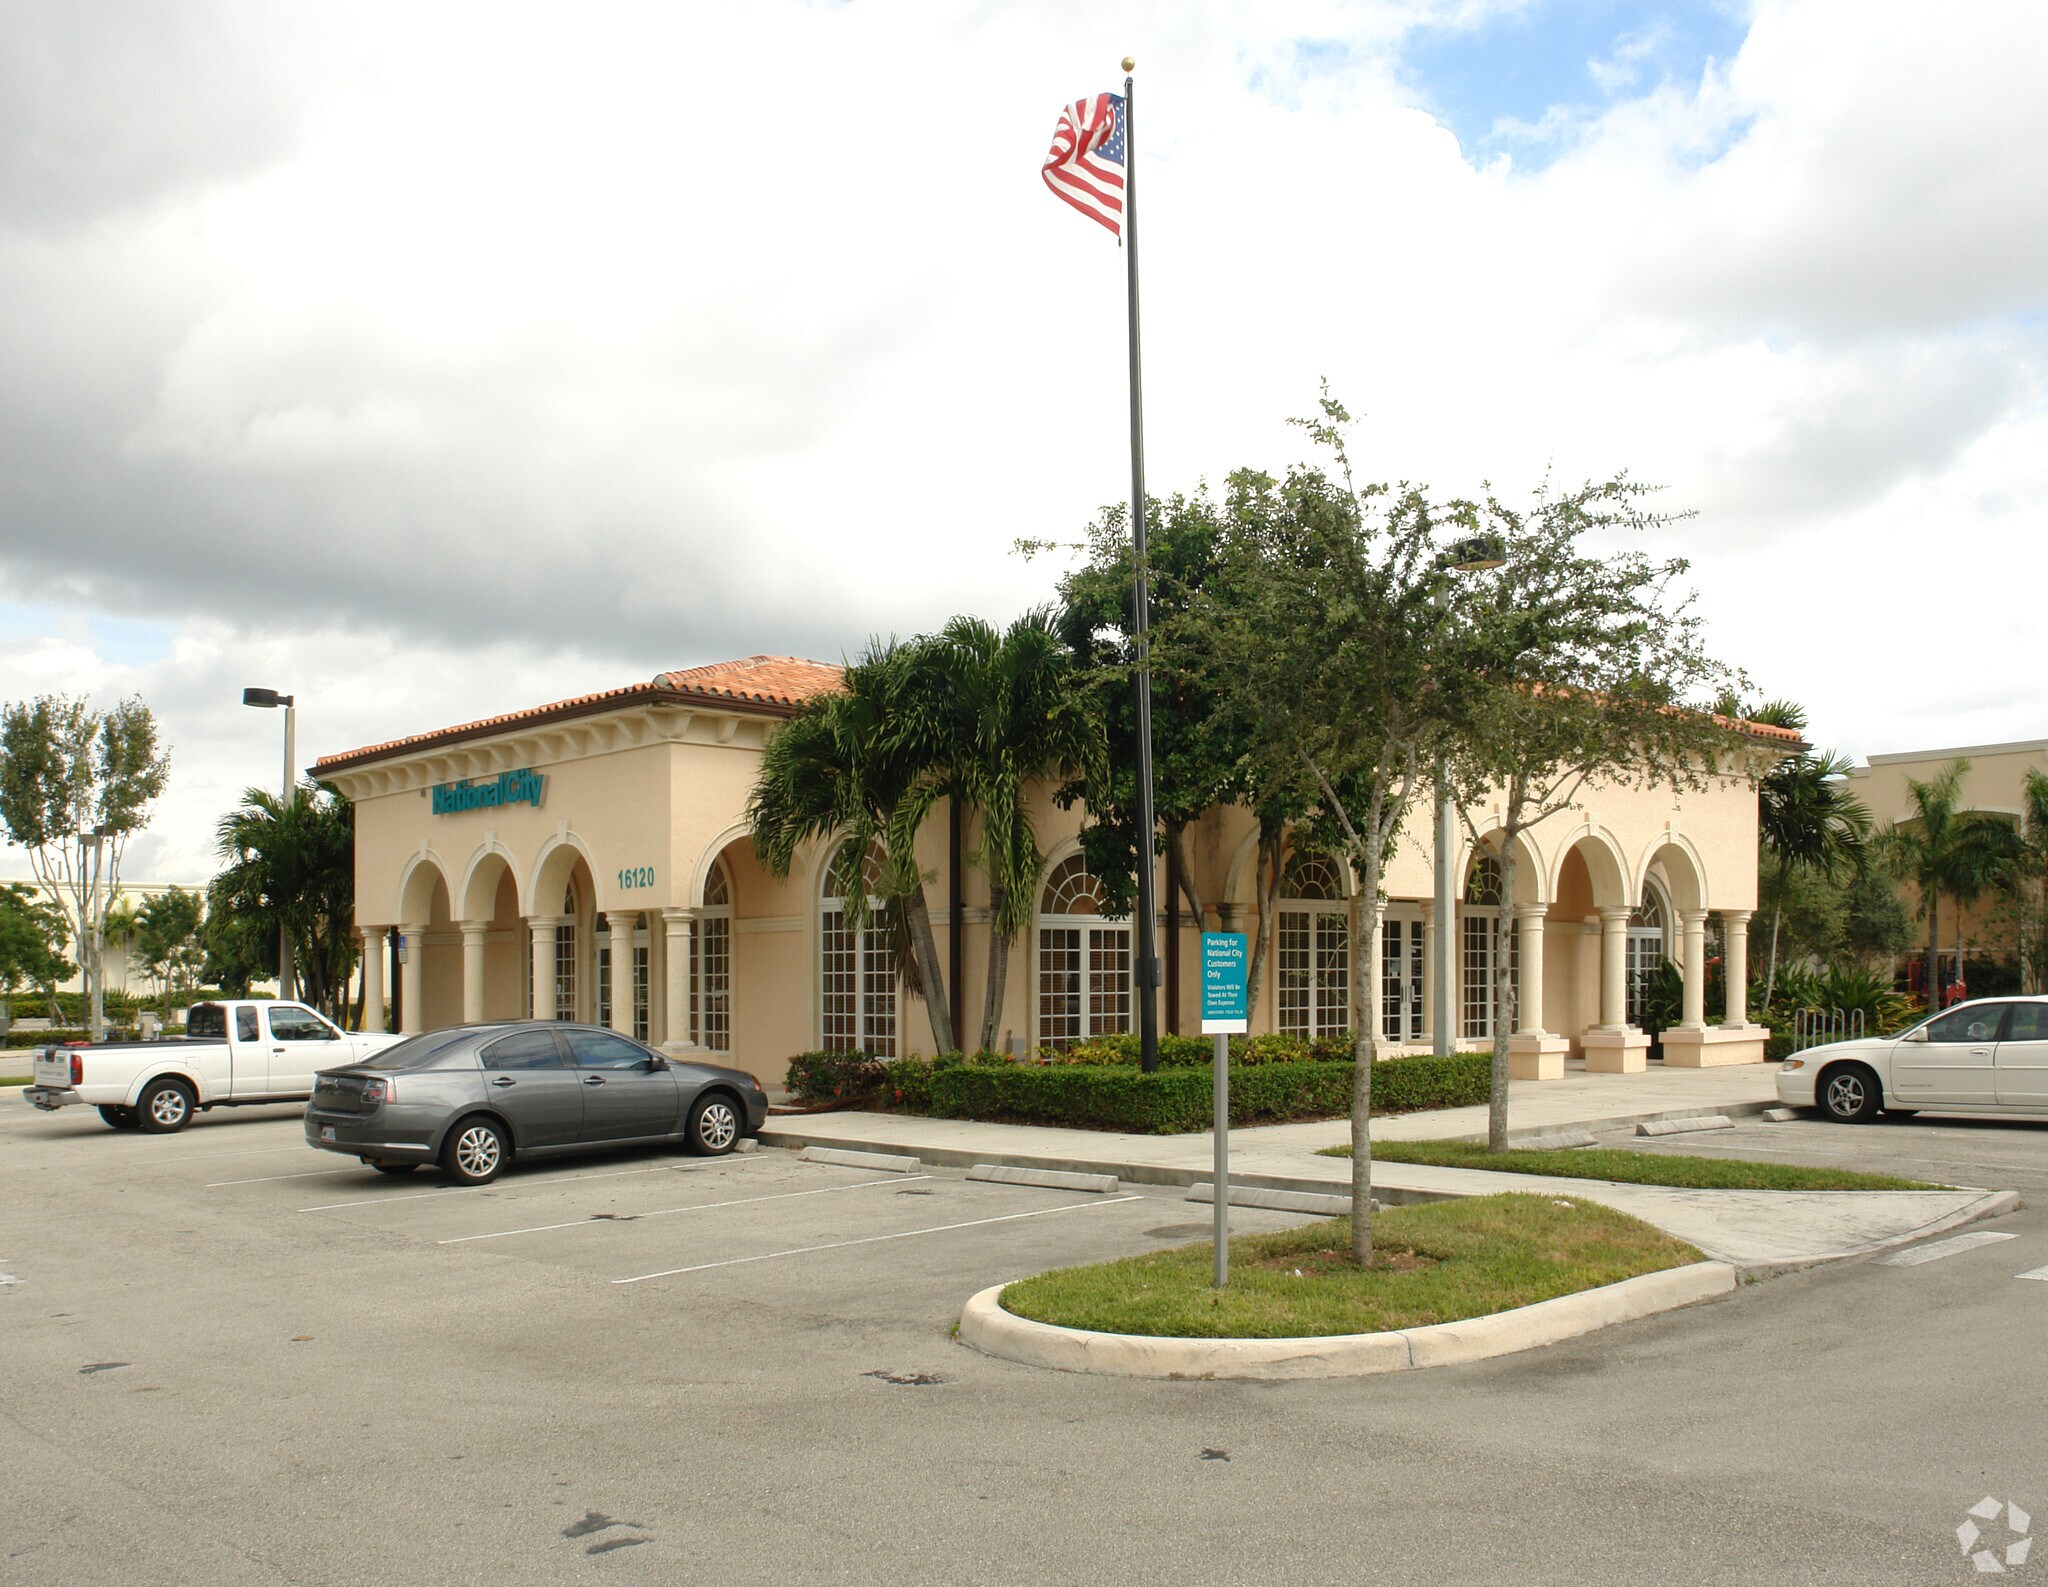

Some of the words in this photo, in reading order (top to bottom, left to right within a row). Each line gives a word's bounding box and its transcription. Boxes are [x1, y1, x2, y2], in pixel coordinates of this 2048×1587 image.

[432, 772, 504, 815] National
[505, 768, 544, 807] City
[618, 866, 654, 890] 16120
[1207, 938, 1228, 947] Parking
[1229, 938, 1238, 946] for
[1207, 949, 1231, 957] National
[1232, 949, 1242, 958] City
[1207, 970, 1221, 979] Only
